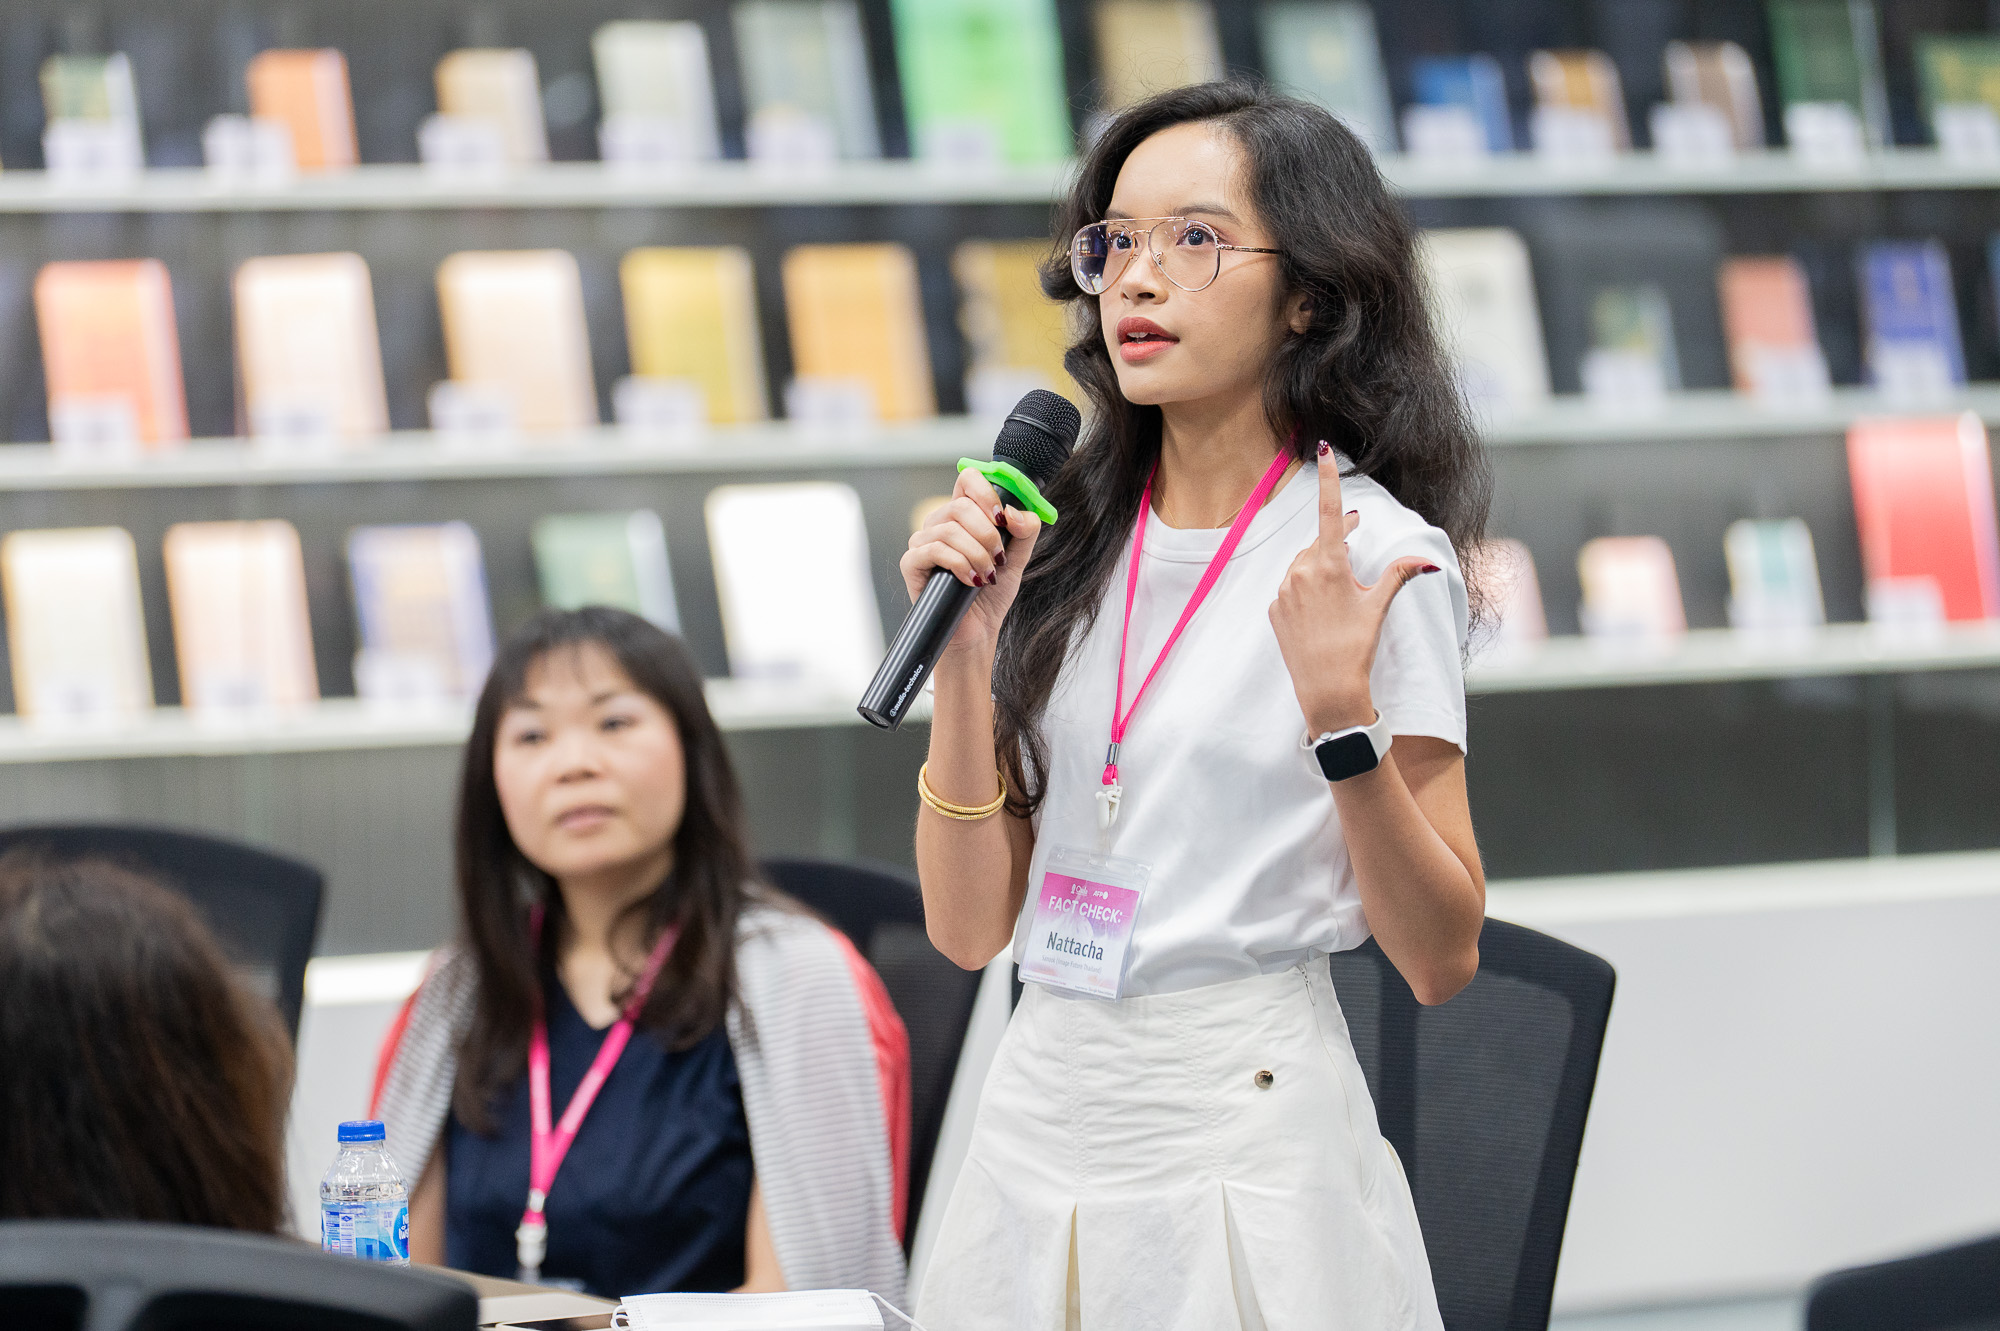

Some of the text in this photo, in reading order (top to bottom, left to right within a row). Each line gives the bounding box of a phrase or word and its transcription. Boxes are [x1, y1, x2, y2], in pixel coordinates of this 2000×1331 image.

[893, 664, 924, 712] audio-technica
[1048, 895, 1123, 924] FACT CHECK:
[1046, 931, 1104, 961] Nattacha
